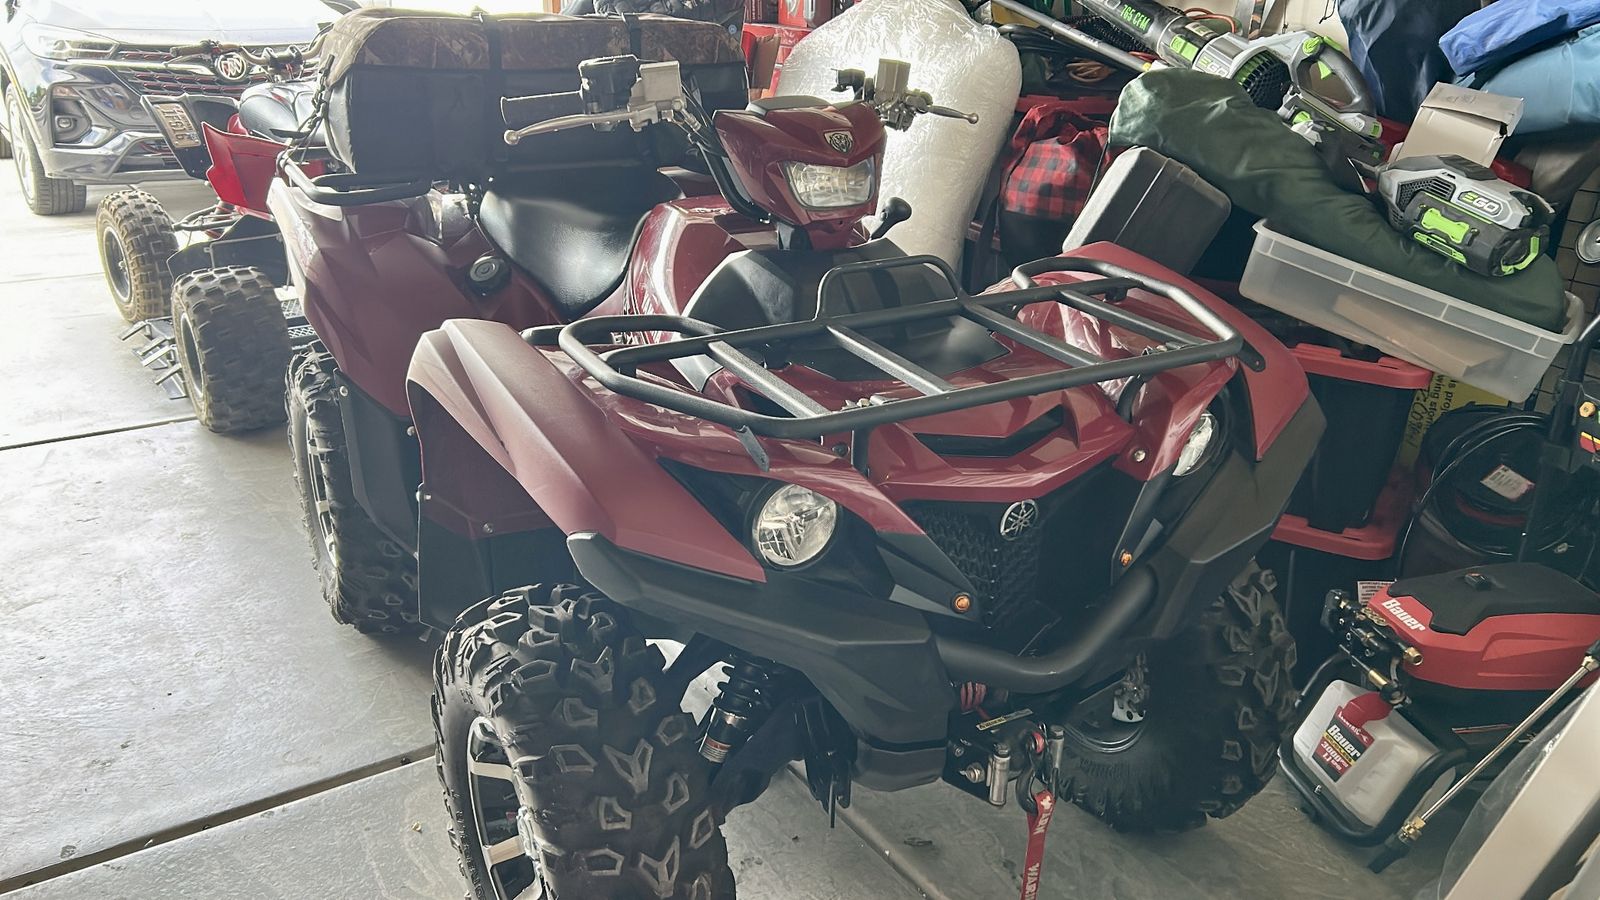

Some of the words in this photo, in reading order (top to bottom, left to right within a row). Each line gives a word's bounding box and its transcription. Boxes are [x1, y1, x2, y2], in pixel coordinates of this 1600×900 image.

[1120, 4, 1136, 22] 765
[1132, 12, 1151, 31] CFM
[1462, 191, 1500, 213] EGO
[1381, 599, 1426, 631] Bauer
[1328, 725, 1361, 757] Bauer
